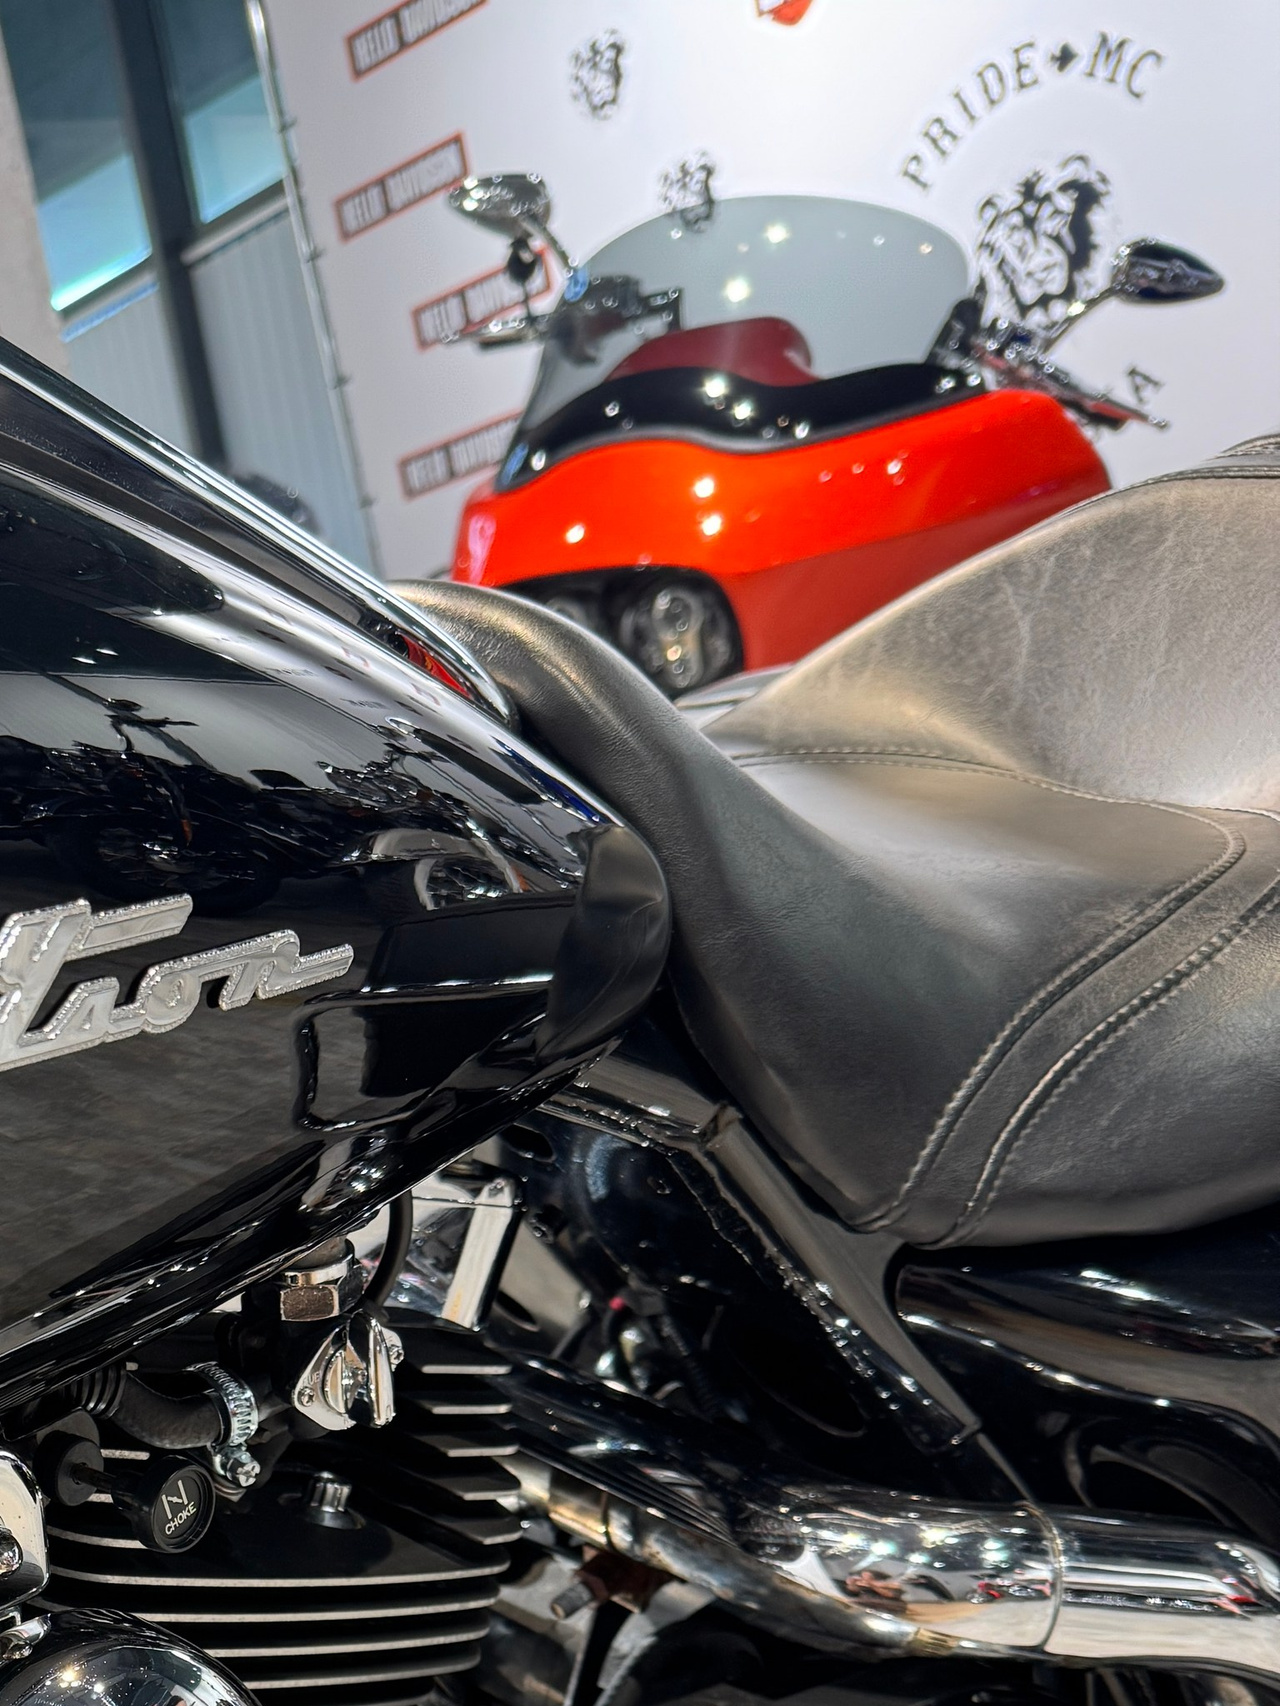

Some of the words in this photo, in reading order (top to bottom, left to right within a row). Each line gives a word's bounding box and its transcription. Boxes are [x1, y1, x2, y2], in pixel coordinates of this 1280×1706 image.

[901, 41, 1041, 190] PRIDE
[1085, 31, 1163, 100] MC
[165, 1502, 197, 1535] CHOKE
